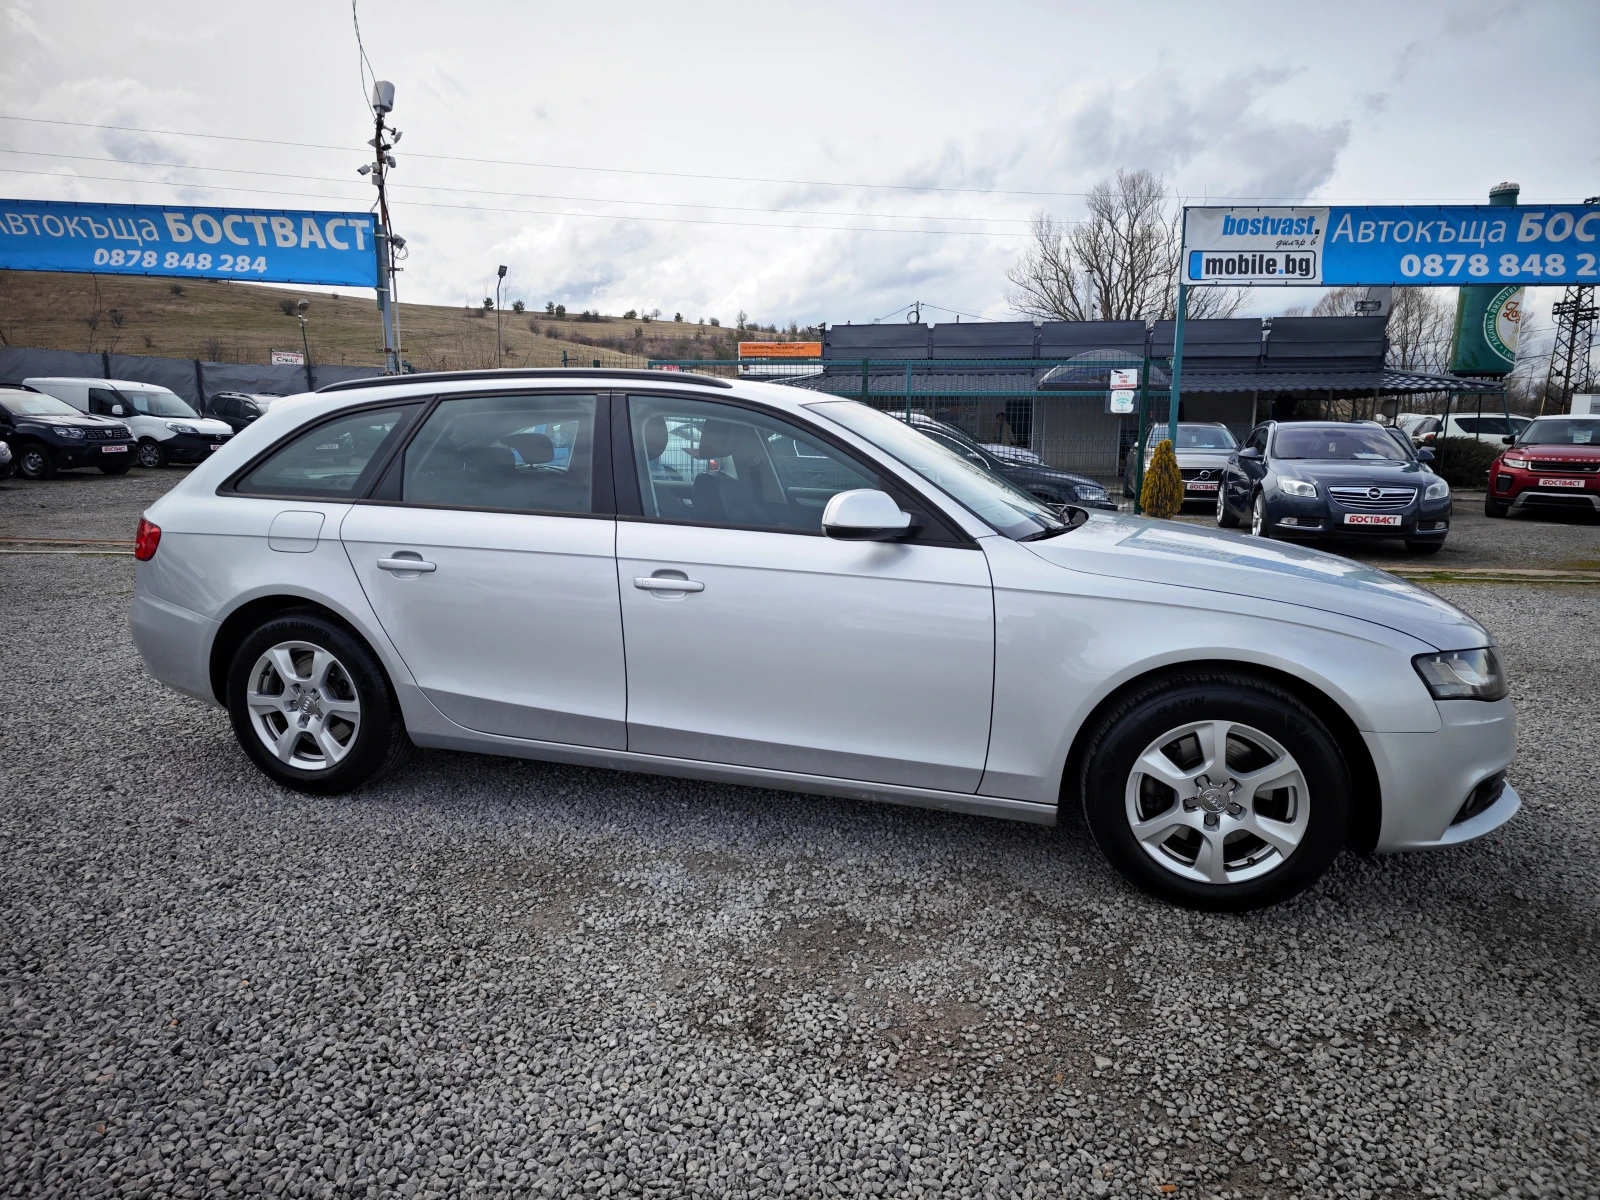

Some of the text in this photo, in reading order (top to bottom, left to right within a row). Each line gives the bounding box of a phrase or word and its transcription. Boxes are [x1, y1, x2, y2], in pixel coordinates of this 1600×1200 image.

[0, 212, 370, 250] втокъща БОСТВАСТ
[1331, 213, 1507, 249] Автокъща
[94, 248, 268, 273] 0878 848 284
[1205, 254, 1311, 277] mobile.bg
[1401, 253, 1600, 277] 0878 848 2
[1487, 314, 1501, 347] ZAGORKA
[1349, 515, 1398, 524] БОСТВАСТ
[289, 621, 331, 642] SUMMER
